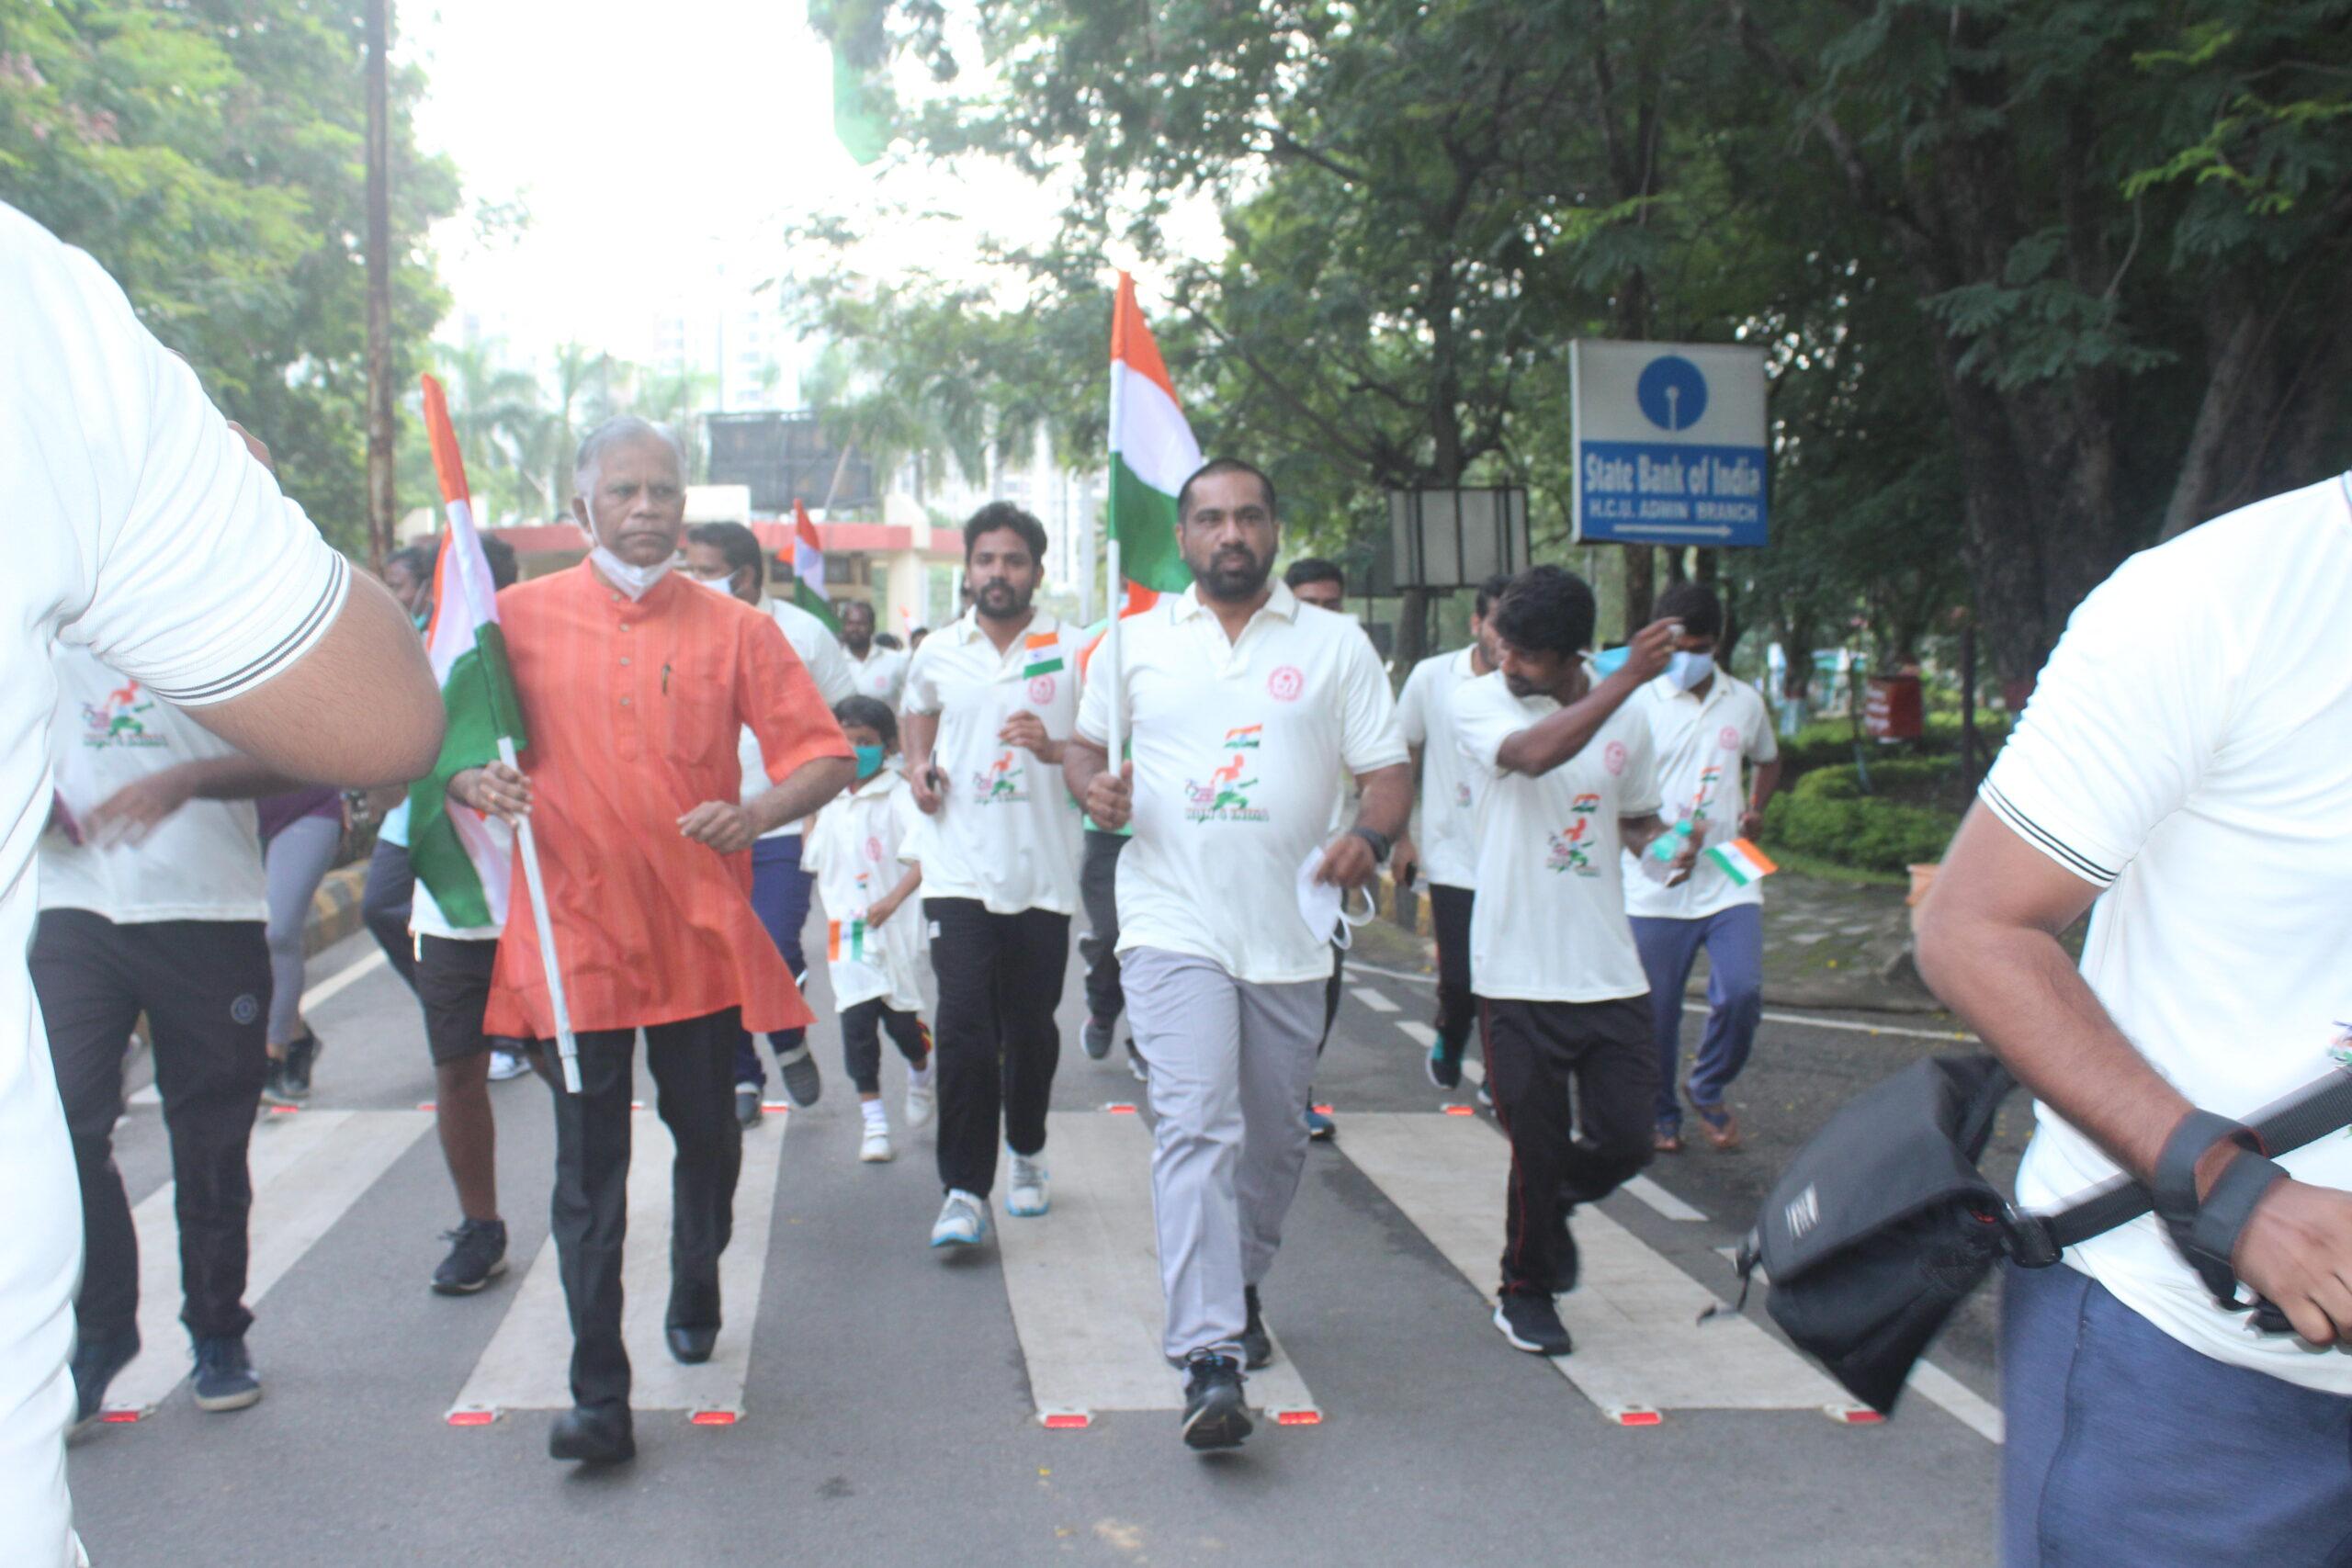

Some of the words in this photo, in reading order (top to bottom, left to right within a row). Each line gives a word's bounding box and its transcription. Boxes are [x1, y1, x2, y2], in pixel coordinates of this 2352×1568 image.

[1586, 453, 1634, 492] State
[1638, 454, 1685, 493] Bank
[1688, 455, 1709, 495] of
[1713, 457, 1761, 497] India
[1638, 500, 1689, 520] ADMIN
[1696, 502, 1758, 522] BRANCH
